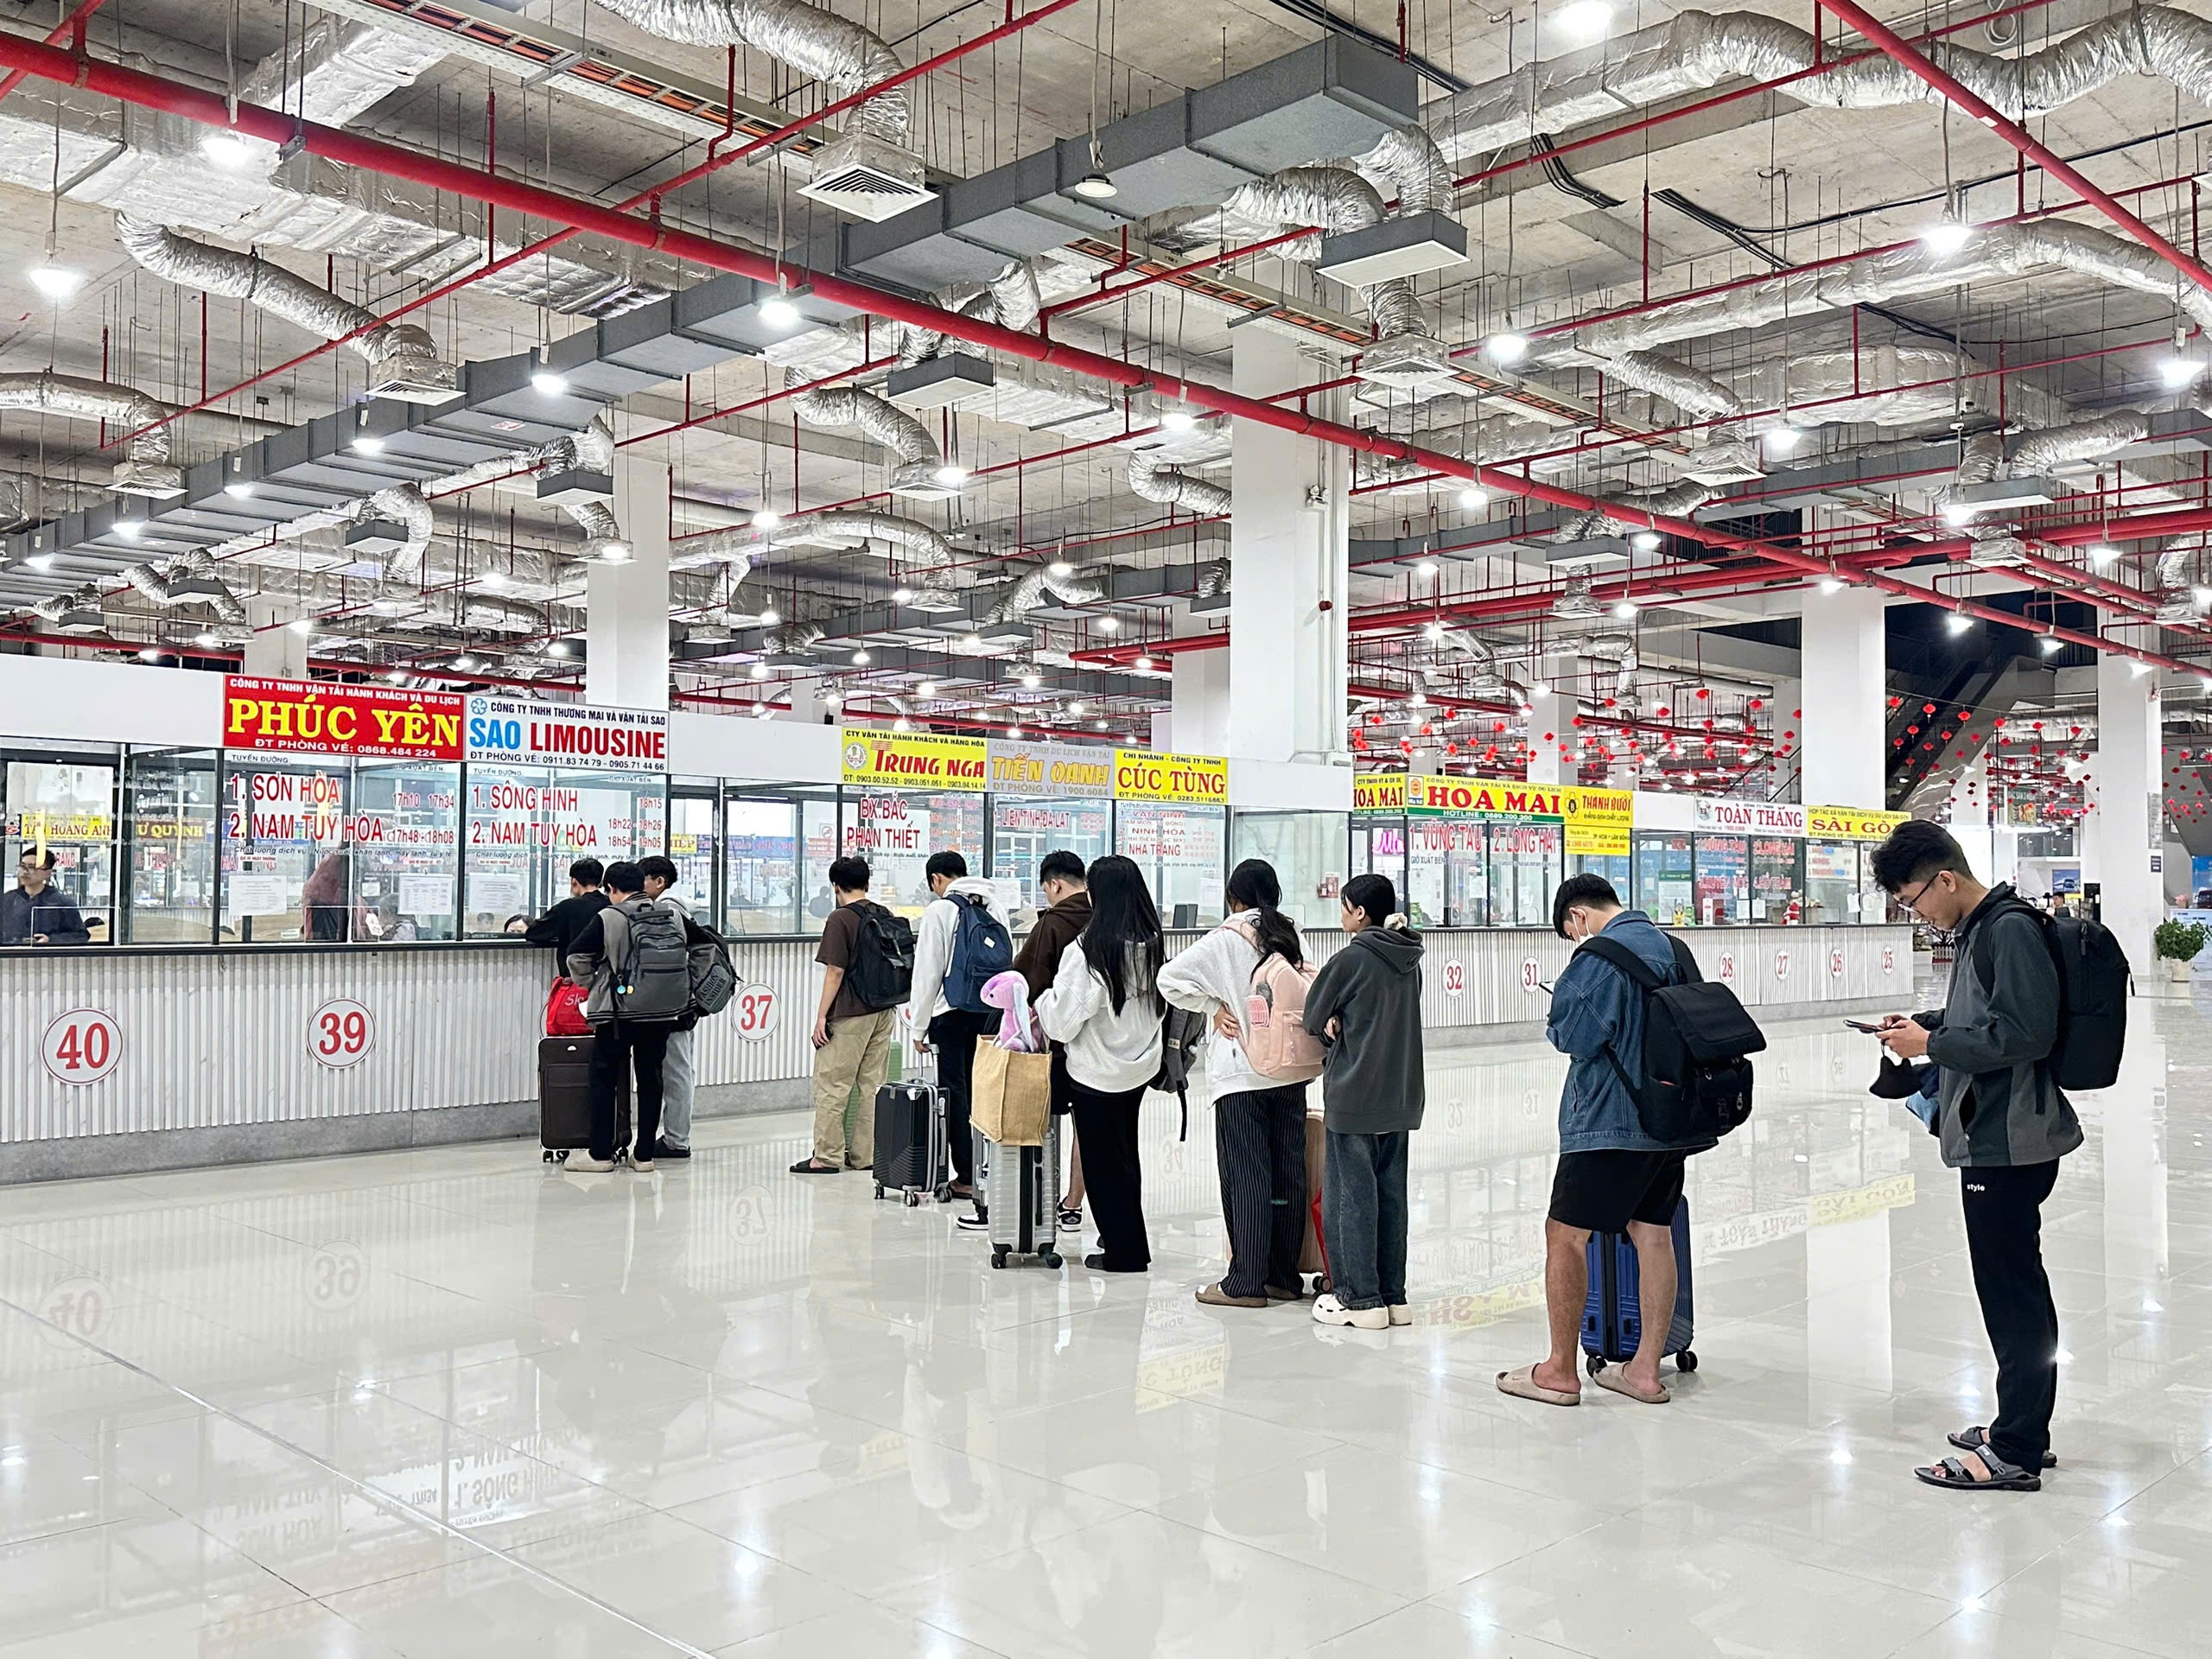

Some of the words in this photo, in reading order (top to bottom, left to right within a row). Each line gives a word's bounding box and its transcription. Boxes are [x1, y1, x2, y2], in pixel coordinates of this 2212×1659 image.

[230, 677, 259, 690] CÔNG
[262, 681, 274, 691] TY
[276, 682, 302, 693] TNHH
[346, 686, 373, 699] HÀNH
[375, 689, 408, 702] KHÁCH
[410, 690, 423, 702] VÀ
[424, 694, 437, 705] DU
[439, 695, 461, 708] LỊCH
[228, 694, 358, 741] PHÚC
[371, 702, 461, 747] YÊN
[491, 701, 515, 714] CÔNG
[517, 704, 527, 715] TY
[529, 705, 552, 717] TNHH
[554, 707, 587, 721] THƯƠNG
[606, 709, 617, 722] VÀ
[651, 715, 666, 726] SAO
[255, 739, 273, 748] ĐT
[277, 739, 328, 753] PHÒNG
[331, 741, 353, 753] VÉ:
[357, 745, 412, 757] 0868.484
[415, 747, 437, 759] 224
[469, 717, 521, 750] SAO
[530, 722, 666, 760] LIMOUSINE
[470, 752, 484, 760] ĐT
[486, 751, 522, 764] PHÒNG
[578, 758, 589, 767] 74
[591, 759, 602, 768] 79
[654, 762, 665, 771] 66
[946, 758, 985, 779] NGA
[992, 752, 1044, 783] TIẾN
[1171, 755, 1191, 764] CÔNG
[231, 774, 246, 800] 1.
[252, 772, 293, 801] SƠN
[300, 770, 340, 804] HÒA
[1117, 762, 1162, 791] CÚC
[1169, 766, 1226, 794] TÙNG
[391, 791, 421, 807] 17h10
[427, 793, 454, 809] 17h34
[474, 785, 486, 810] 1.
[491, 780, 537, 810] SÔNG
[542, 787, 579, 812] HINH
[639, 798, 663, 810] 18h15
[861, 790, 908, 821] BX.BẮC
[1379, 787, 1403, 807] MAI
[1427, 785, 1496, 810] HOA
[1504, 791, 1560, 814] MAI
[229, 812, 246, 840] 2.
[252, 813, 295, 840] NAM
[302, 815, 340, 842] TUY
[343, 810, 384, 842] HÒA
[607, 818, 632, 830] 18h22
[639, 819, 662, 831] 18h26
[1715, 803, 1752, 824] TOÀN
[1757, 805, 1802, 828] THẮNG
[1812, 817, 1853, 832] SÀI
[1861, 820, 1898, 834] GÒ
[391, 828, 419, 843] 17h48
[427, 829, 454, 845] 18h08
[473, 821, 486, 845] 2.
[491, 822, 526, 846] NAM
[530, 823, 562, 847] TUY
[564, 817, 598, 848] HÒA
[607, 835, 632, 848] 18h54
[639, 836, 662, 849] 19h05
[847, 826, 881, 848] PHAN
[886, 820, 921, 849] THIẾT
[1128, 843, 1148, 855] NHA
[1150, 843, 1181, 857] TRANG
[1722, 957, 1733, 977] 28
[1777, 956, 1788, 975] 27
[1832, 954, 1842, 972] 26
[1884, 951, 1893, 969] 25
[1446, 966, 1463, 990] 32
[1524, 963, 1538, 986] 31
[741, 995, 772, 1031] 37
[319, 1011, 366, 1056] 39
[55, 1022, 110, 1070] 40
